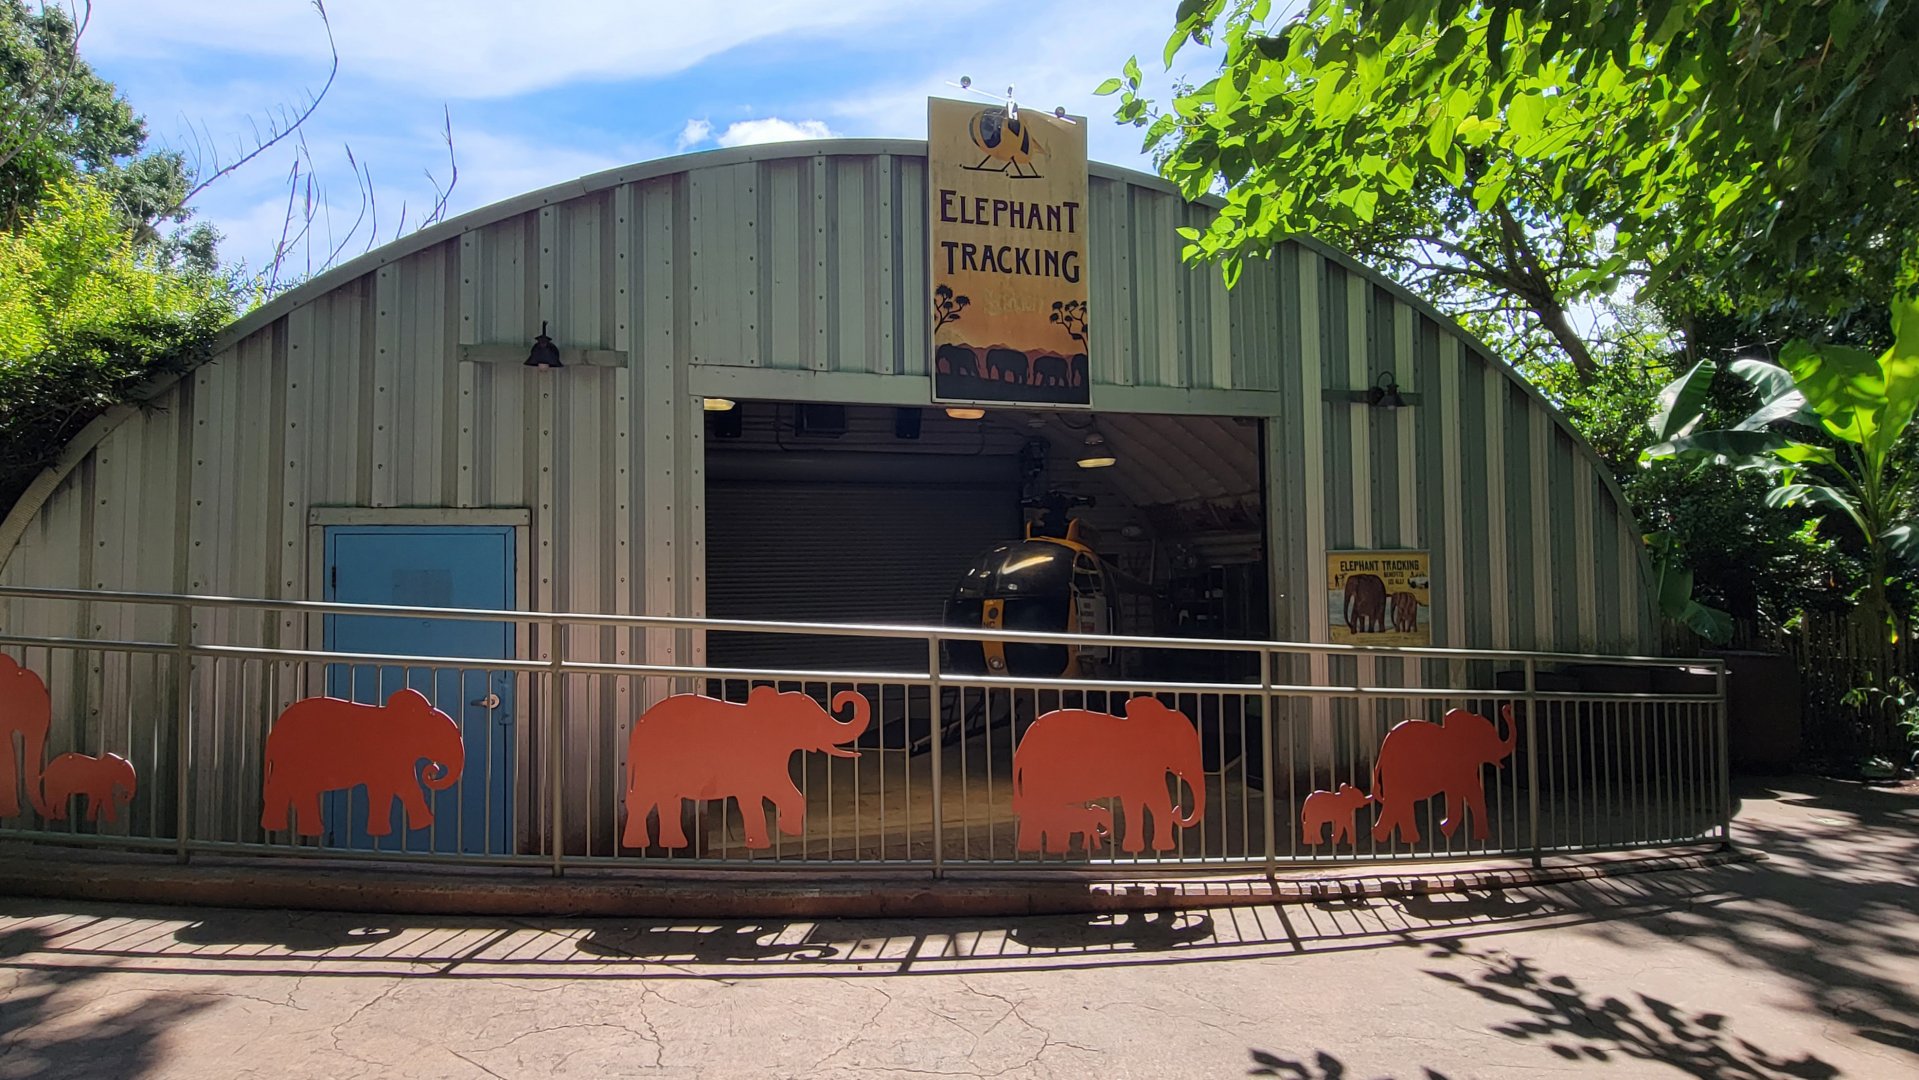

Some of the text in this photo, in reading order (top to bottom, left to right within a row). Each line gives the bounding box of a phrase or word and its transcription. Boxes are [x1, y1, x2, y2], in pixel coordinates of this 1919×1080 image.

[940, 189, 1079, 233] ELEPHANT
[941, 241, 1080, 283] TRACKING
[1340, 560, 1419, 572] ELEPHANT TRACKING
